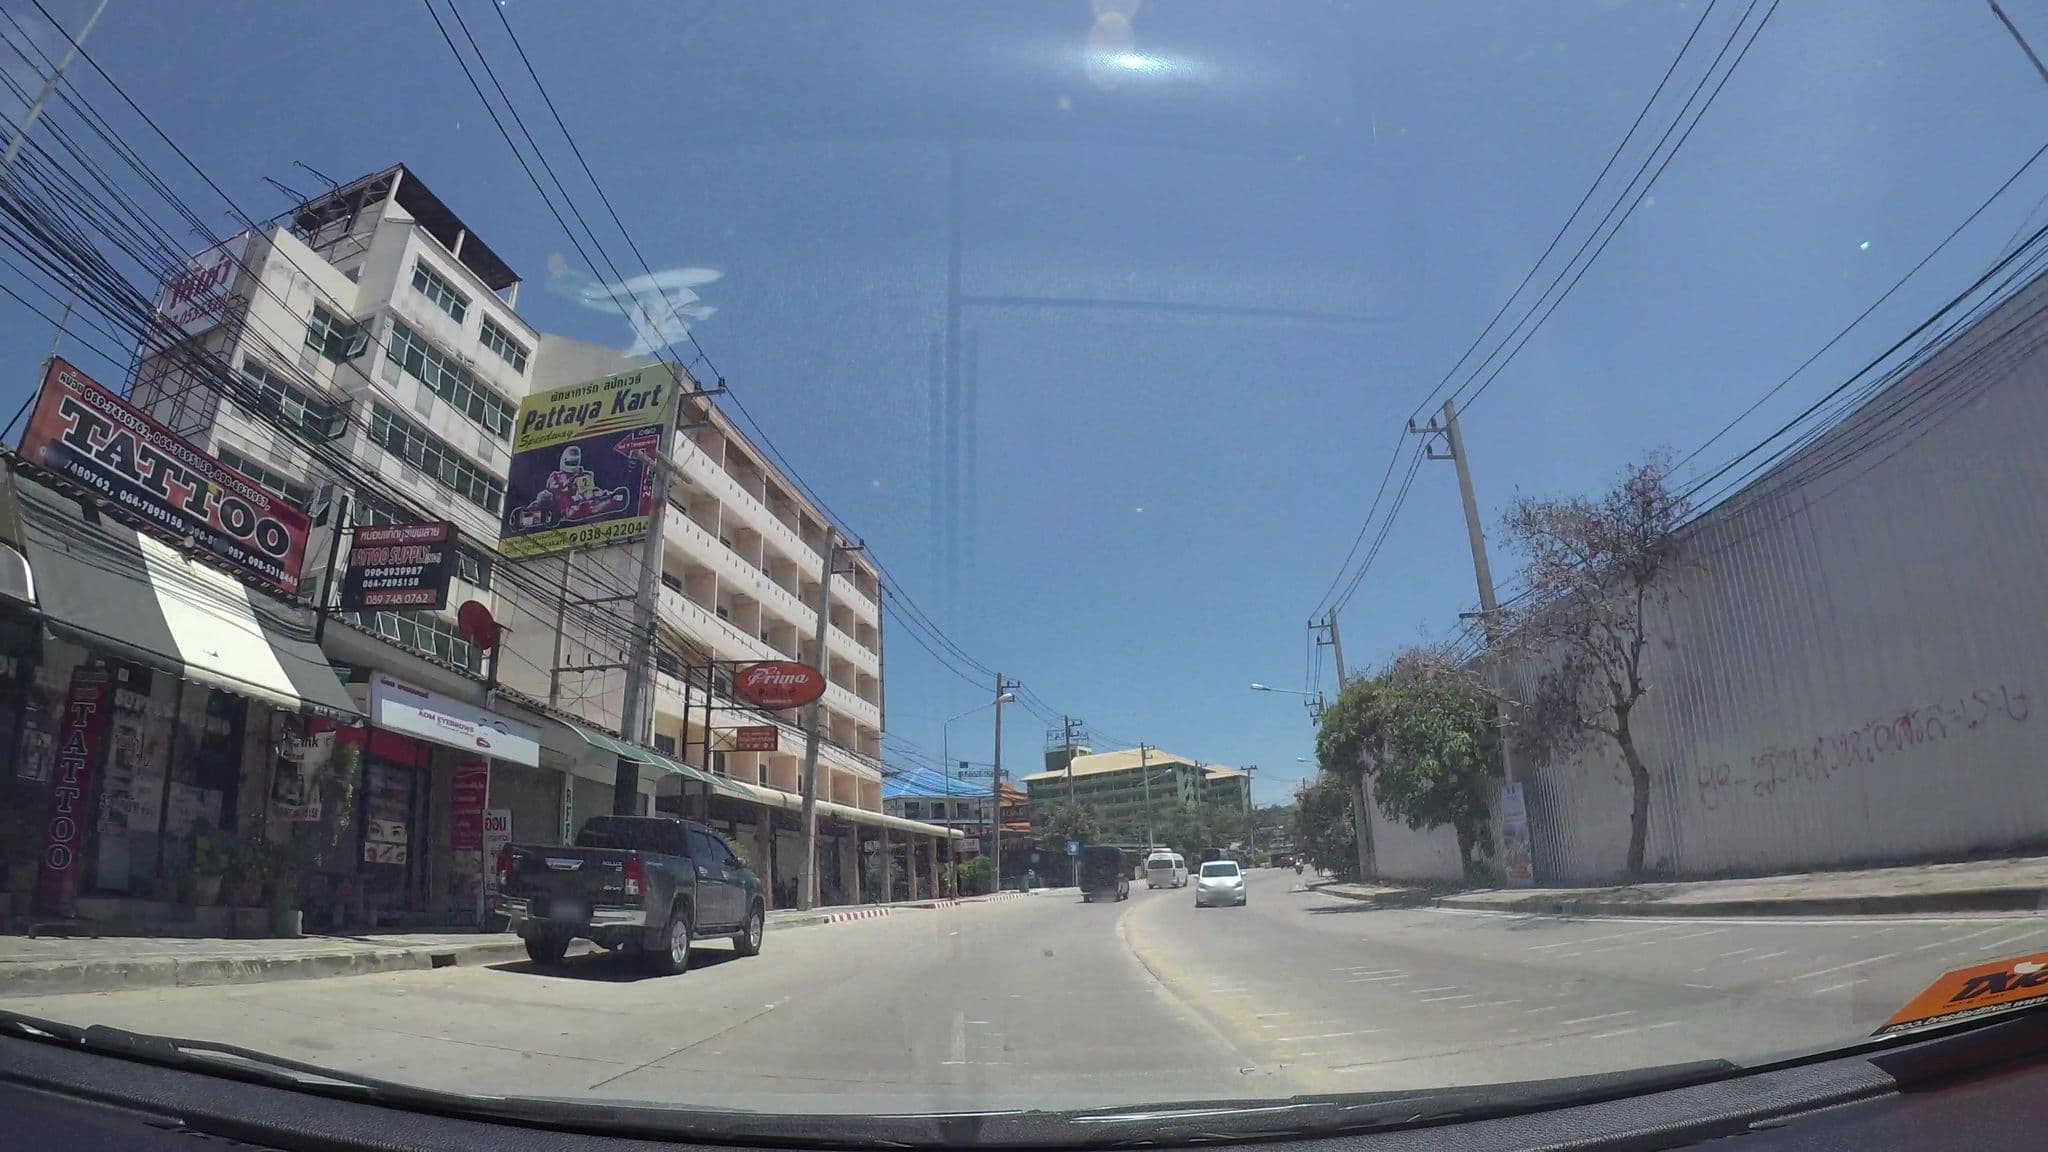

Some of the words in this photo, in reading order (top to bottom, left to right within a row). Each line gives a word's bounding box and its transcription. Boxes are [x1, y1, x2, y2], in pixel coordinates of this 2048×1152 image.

[522, 401, 602, 434] Pattaya
[611, 384, 662, 414] Kart
[518, 430, 574, 449] Speedway
[59, 394, 291, 558] TATTOO
[388, 545, 431, 564] SUPPLY
[404, 593, 428, 604] 0762
[748, 666, 808, 687] Prima
[48, 701, 97, 870] TATTOO
